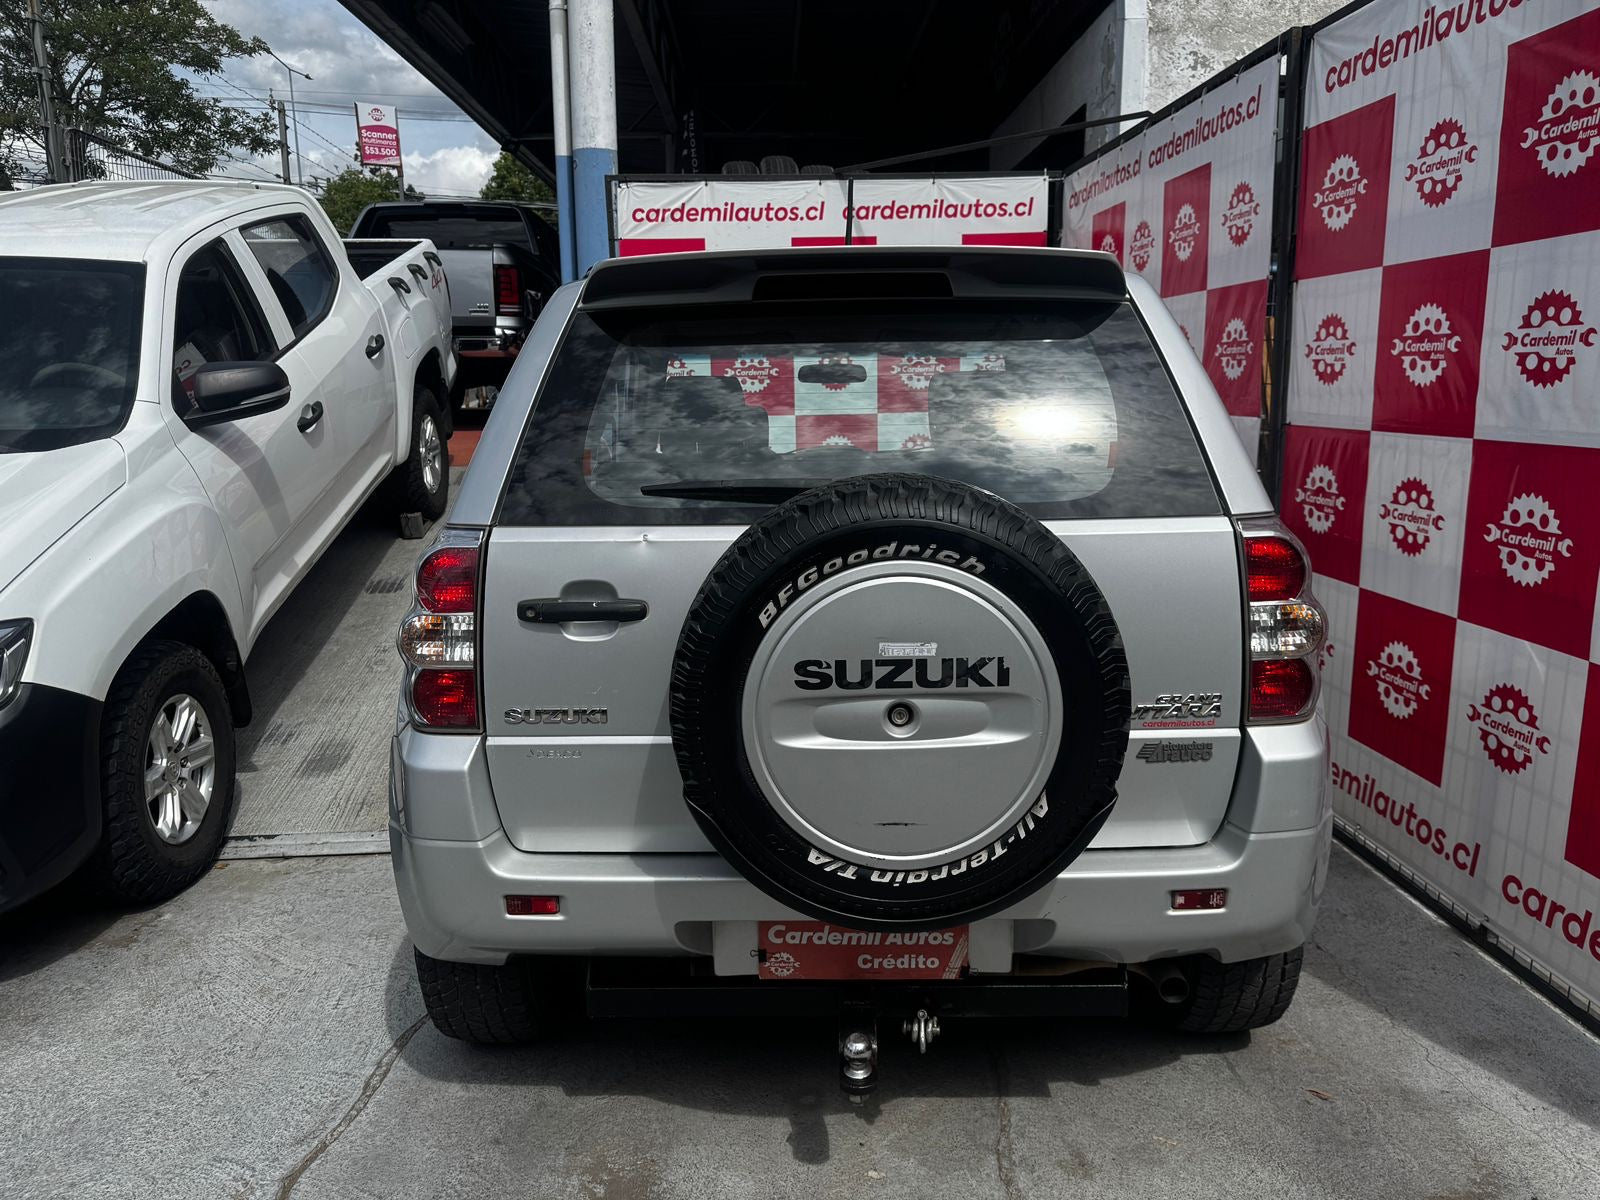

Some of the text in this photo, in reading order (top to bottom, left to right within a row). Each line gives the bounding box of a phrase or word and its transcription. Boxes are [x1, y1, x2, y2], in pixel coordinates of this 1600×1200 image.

[1325, 0, 1526, 93] cardemilauto
[1148, 84, 1262, 169] cardemilautos.cl
[1541, 107, 1600, 140] Cardemil
[361, 129, 397, 140] Scanner
[362, 137, 397, 146] Multimarca
[1577, 128, 1598, 140] Autos
[364, 146, 397, 156] $53.500
[1419, 153, 1463, 176] Cardemil
[1068, 150, 1142, 209] cardemilautos.cl
[1323, 182, 1356, 203] Cardemil
[631, 200, 825, 223] cardemilautos.cl
[1404, 337, 1446, 353] Cardemil
[1520, 330, 1577, 348] Cardemil
[1314, 344, 1345, 356] Cardemil
[1554, 347, 1574, 356] Autos
[735, 366, 770, 378] Cardemil
[1305, 491, 1336, 507] Cardemil
[1391, 508, 1432, 526] Cardemil
[1502, 529, 1556, 552] Cardemil
[1534, 551, 1553, 561] Autos
[758, 541, 988, 630] BFGoodrich
[793, 656, 1010, 691] SUZUKI
[1379, 667, 1419, 694] Cardemil
[1155, 692, 1222, 705] GRAND
[504, 707, 608, 725] SUZUKI
[1482, 713, 1535, 744] Cardemil
[1513, 739, 1531, 754] Autos
[1331, 761, 1481, 878] emilautos.cl
[767, 925, 881, 945] Cardemil
[857, 954, 940, 970] Crédito
